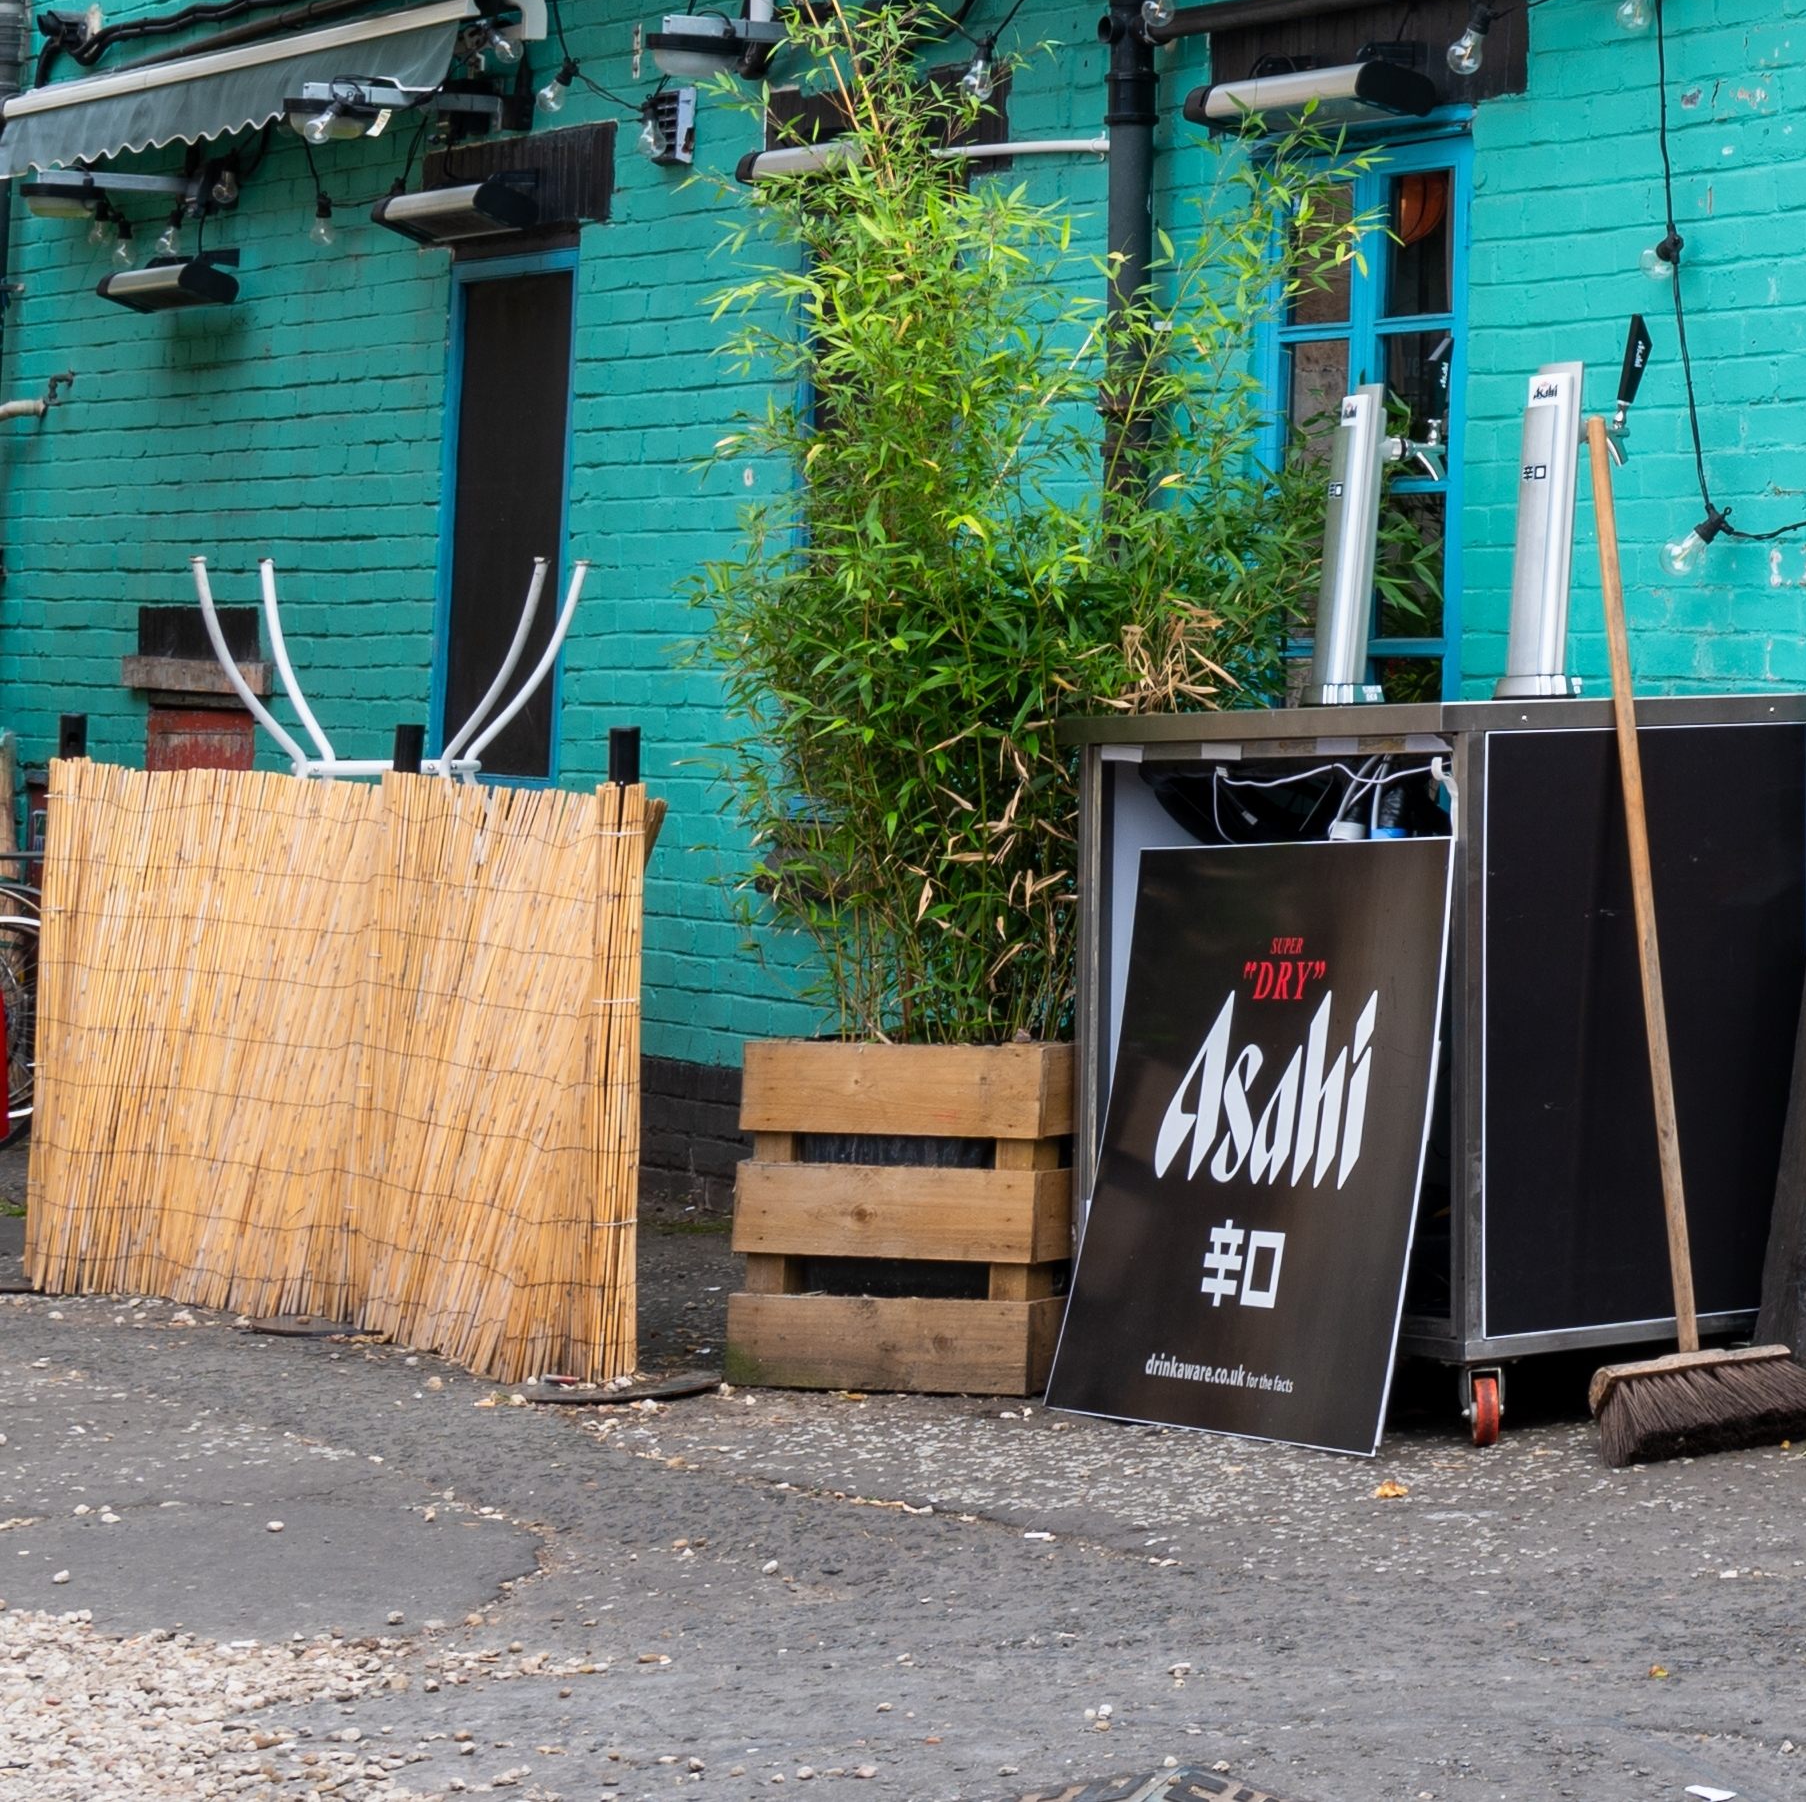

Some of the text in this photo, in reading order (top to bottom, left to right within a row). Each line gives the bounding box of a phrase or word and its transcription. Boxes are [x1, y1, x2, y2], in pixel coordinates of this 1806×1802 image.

[1270, 936, 1304, 955] SUPER
[1154, 990, 1378, 1190] Asahi
[1201, 1219, 1286, 1308] 辛口
[1145, 1353, 1294, 1393] drinkaware.co.uk for the facts
